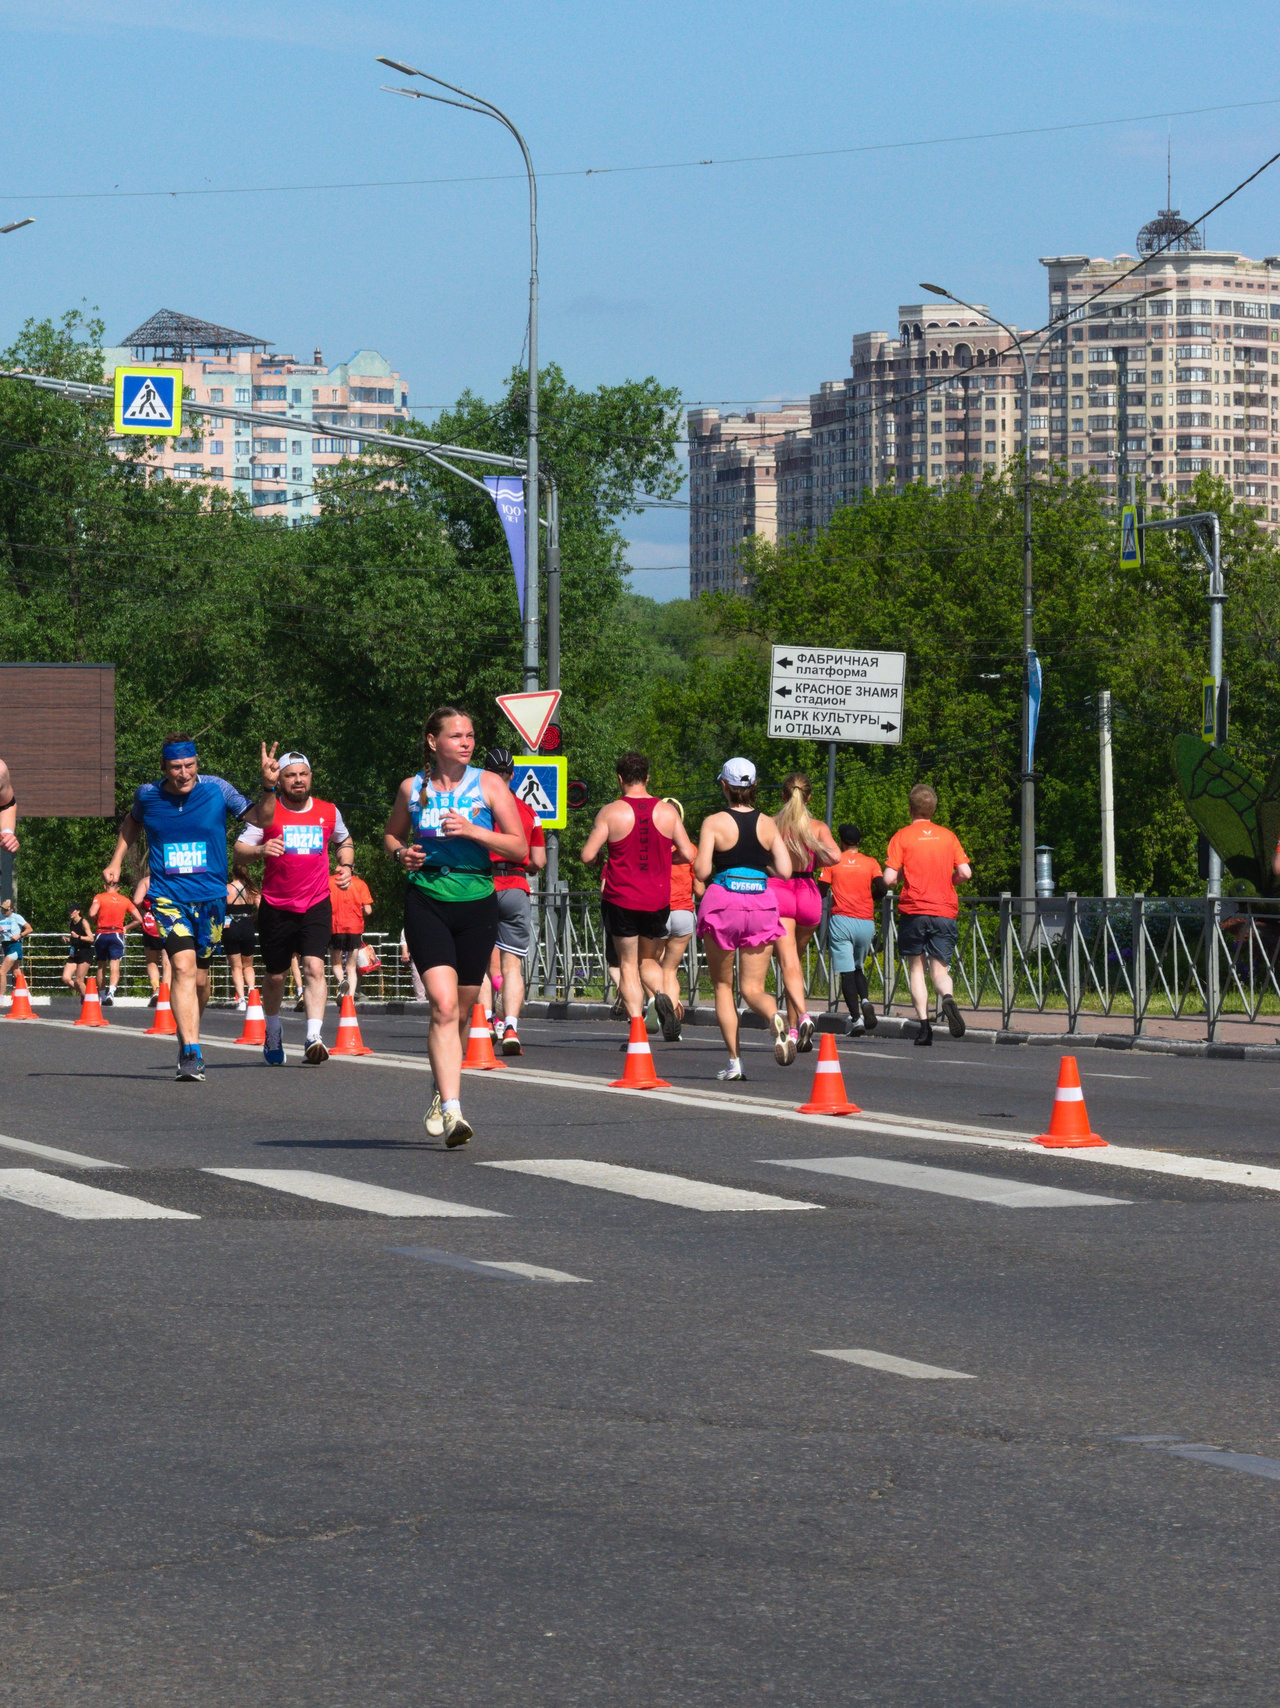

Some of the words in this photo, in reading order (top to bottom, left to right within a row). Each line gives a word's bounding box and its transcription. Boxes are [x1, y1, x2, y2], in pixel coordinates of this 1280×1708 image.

[501, 503, 521, 517] 100
[797, 653, 879, 668] ФАБРИЧНАЯ
[796, 666, 867, 678] платформа
[795, 682, 852, 696] КРАСНОЕ
[855, 686, 898, 699] ЗНАМЯ
[795, 695, 846, 706] стадион
[774, 709, 809, 721] ПАРК
[812, 711, 880, 725] КУЛЬТУРЫ
[774, 724, 782, 733] и
[785, 723, 842, 736] ОТДЫХА
[286, 833, 321, 848] 50274
[168, 850, 202, 867] 50211
[730, 881, 763, 891] СУББОТА
